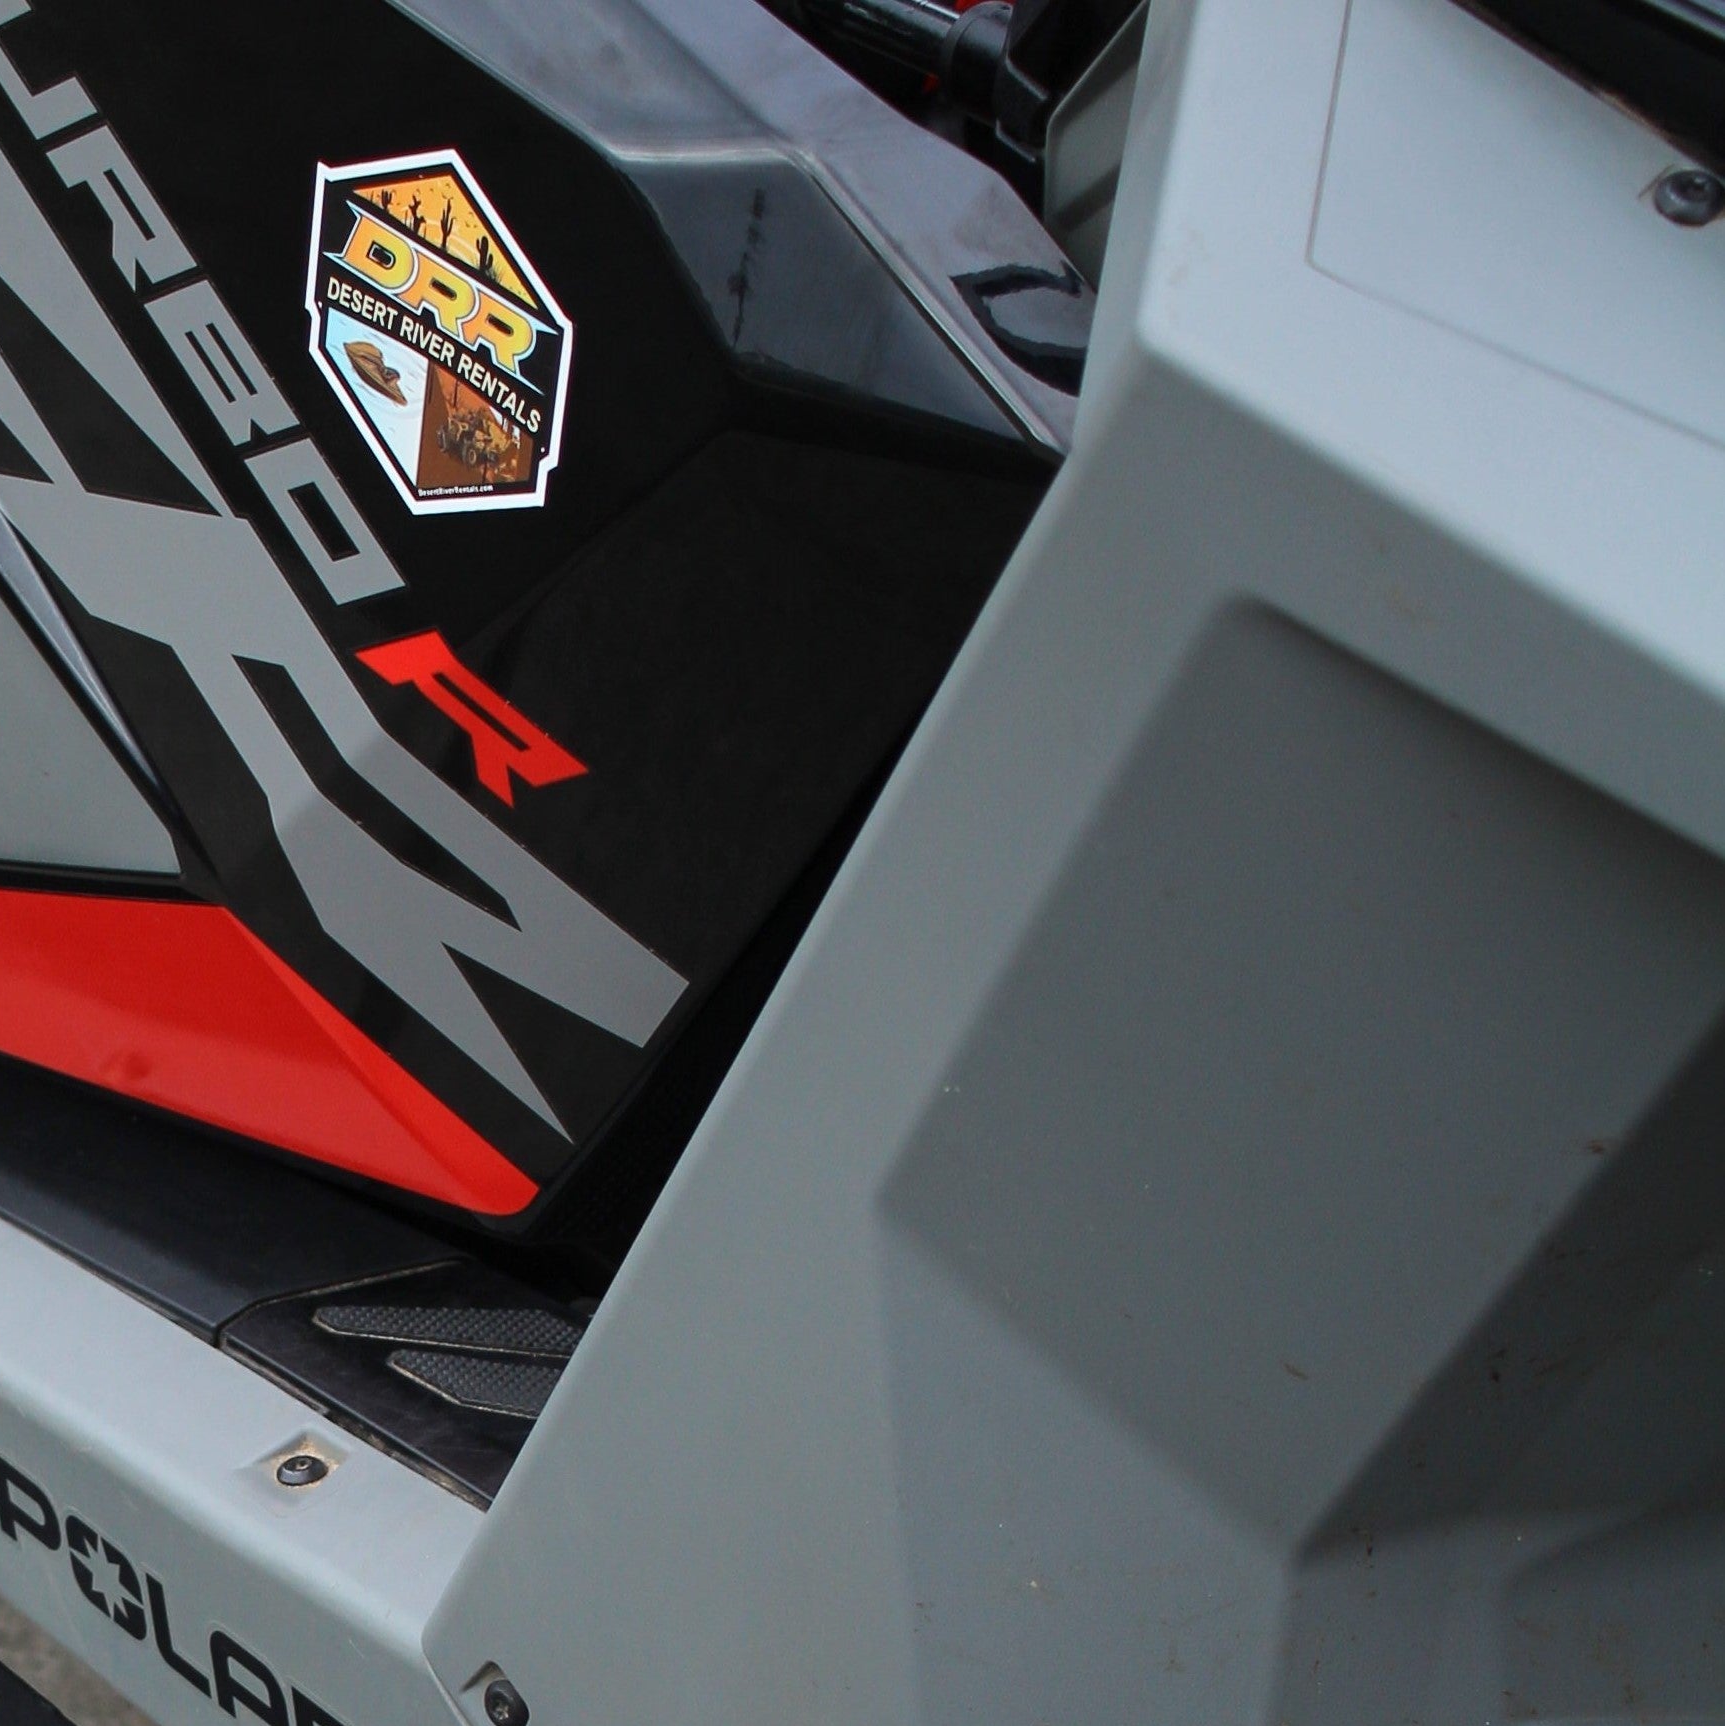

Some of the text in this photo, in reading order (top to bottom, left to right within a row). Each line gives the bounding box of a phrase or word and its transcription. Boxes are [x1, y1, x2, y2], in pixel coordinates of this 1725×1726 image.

[326, 276, 542, 434] DESERT RIVER RENTALS
[340, 212, 535, 374] DRR
[355, 630, 588, 807] R
